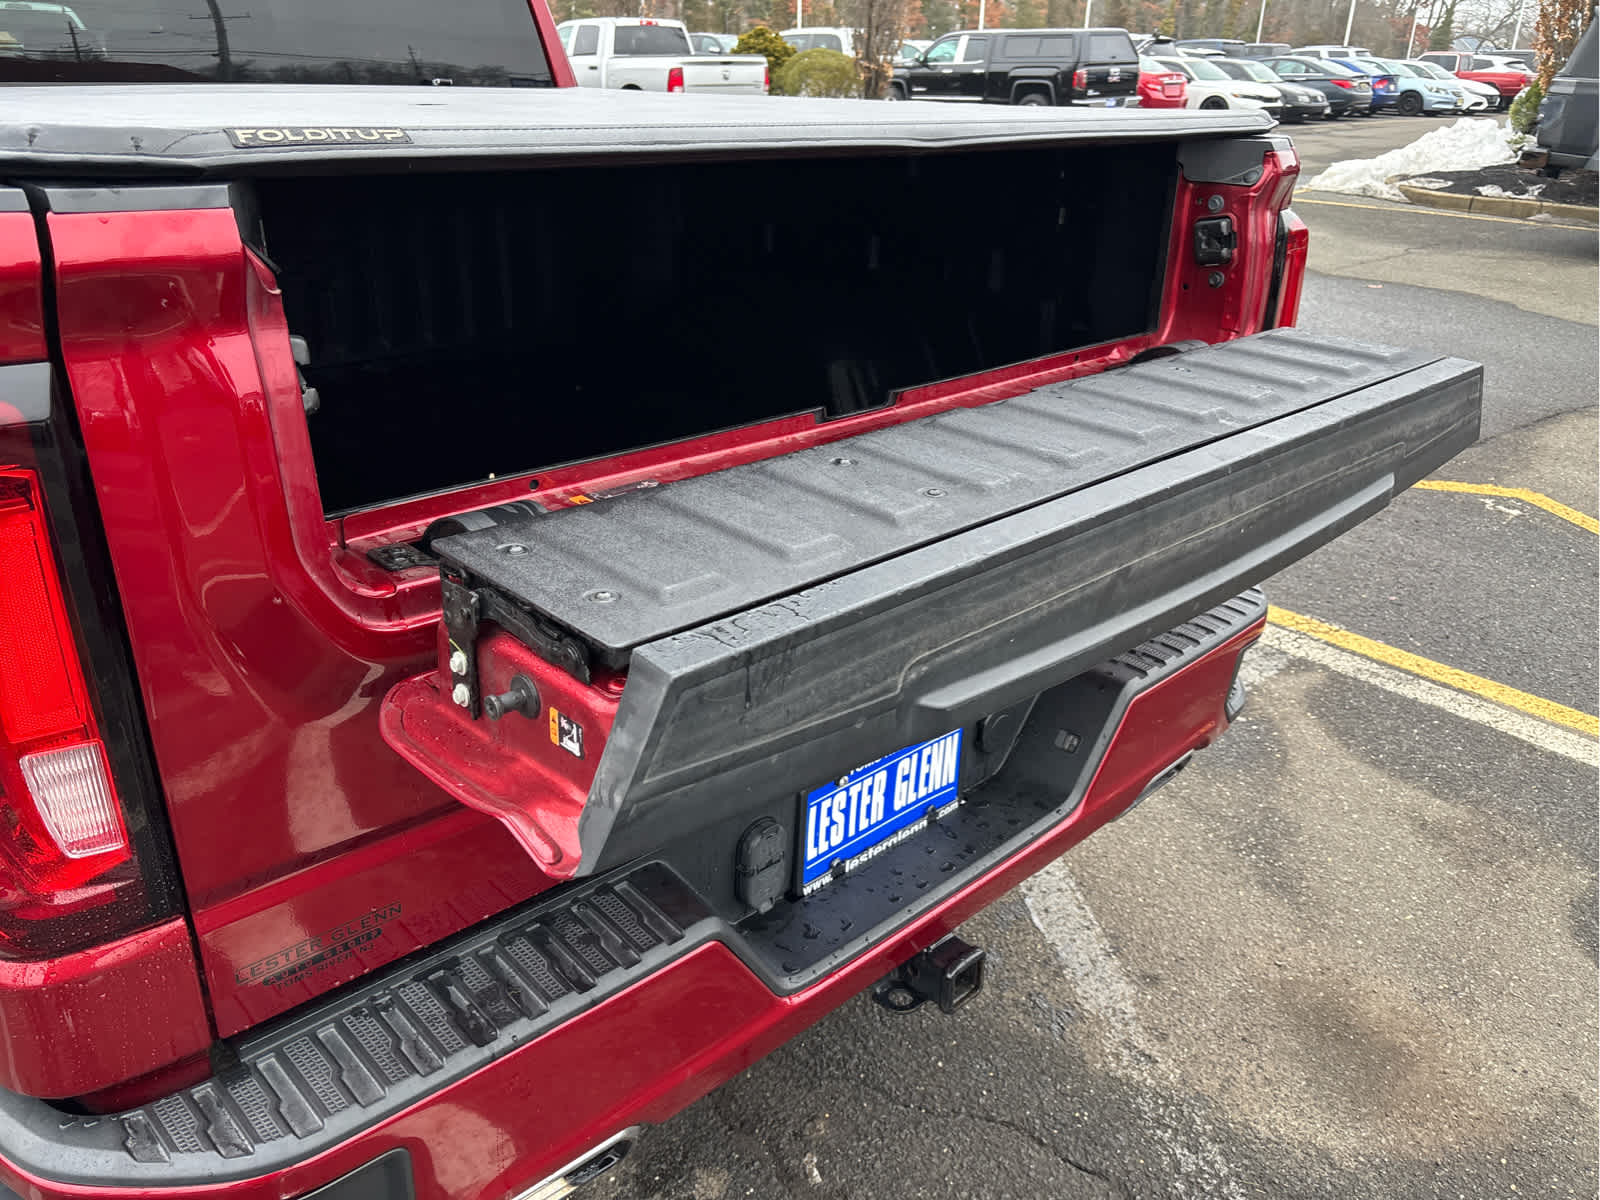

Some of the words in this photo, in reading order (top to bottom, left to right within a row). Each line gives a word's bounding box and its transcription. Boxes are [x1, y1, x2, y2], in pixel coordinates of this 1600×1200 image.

[234, 128, 404, 144] FOLDITUP
[807, 770, 888, 862] LESTER
[893, 732, 960, 811] GLENN
[235, 937, 322, 984] LESTER
[331, 903, 402, 942] GLENN
